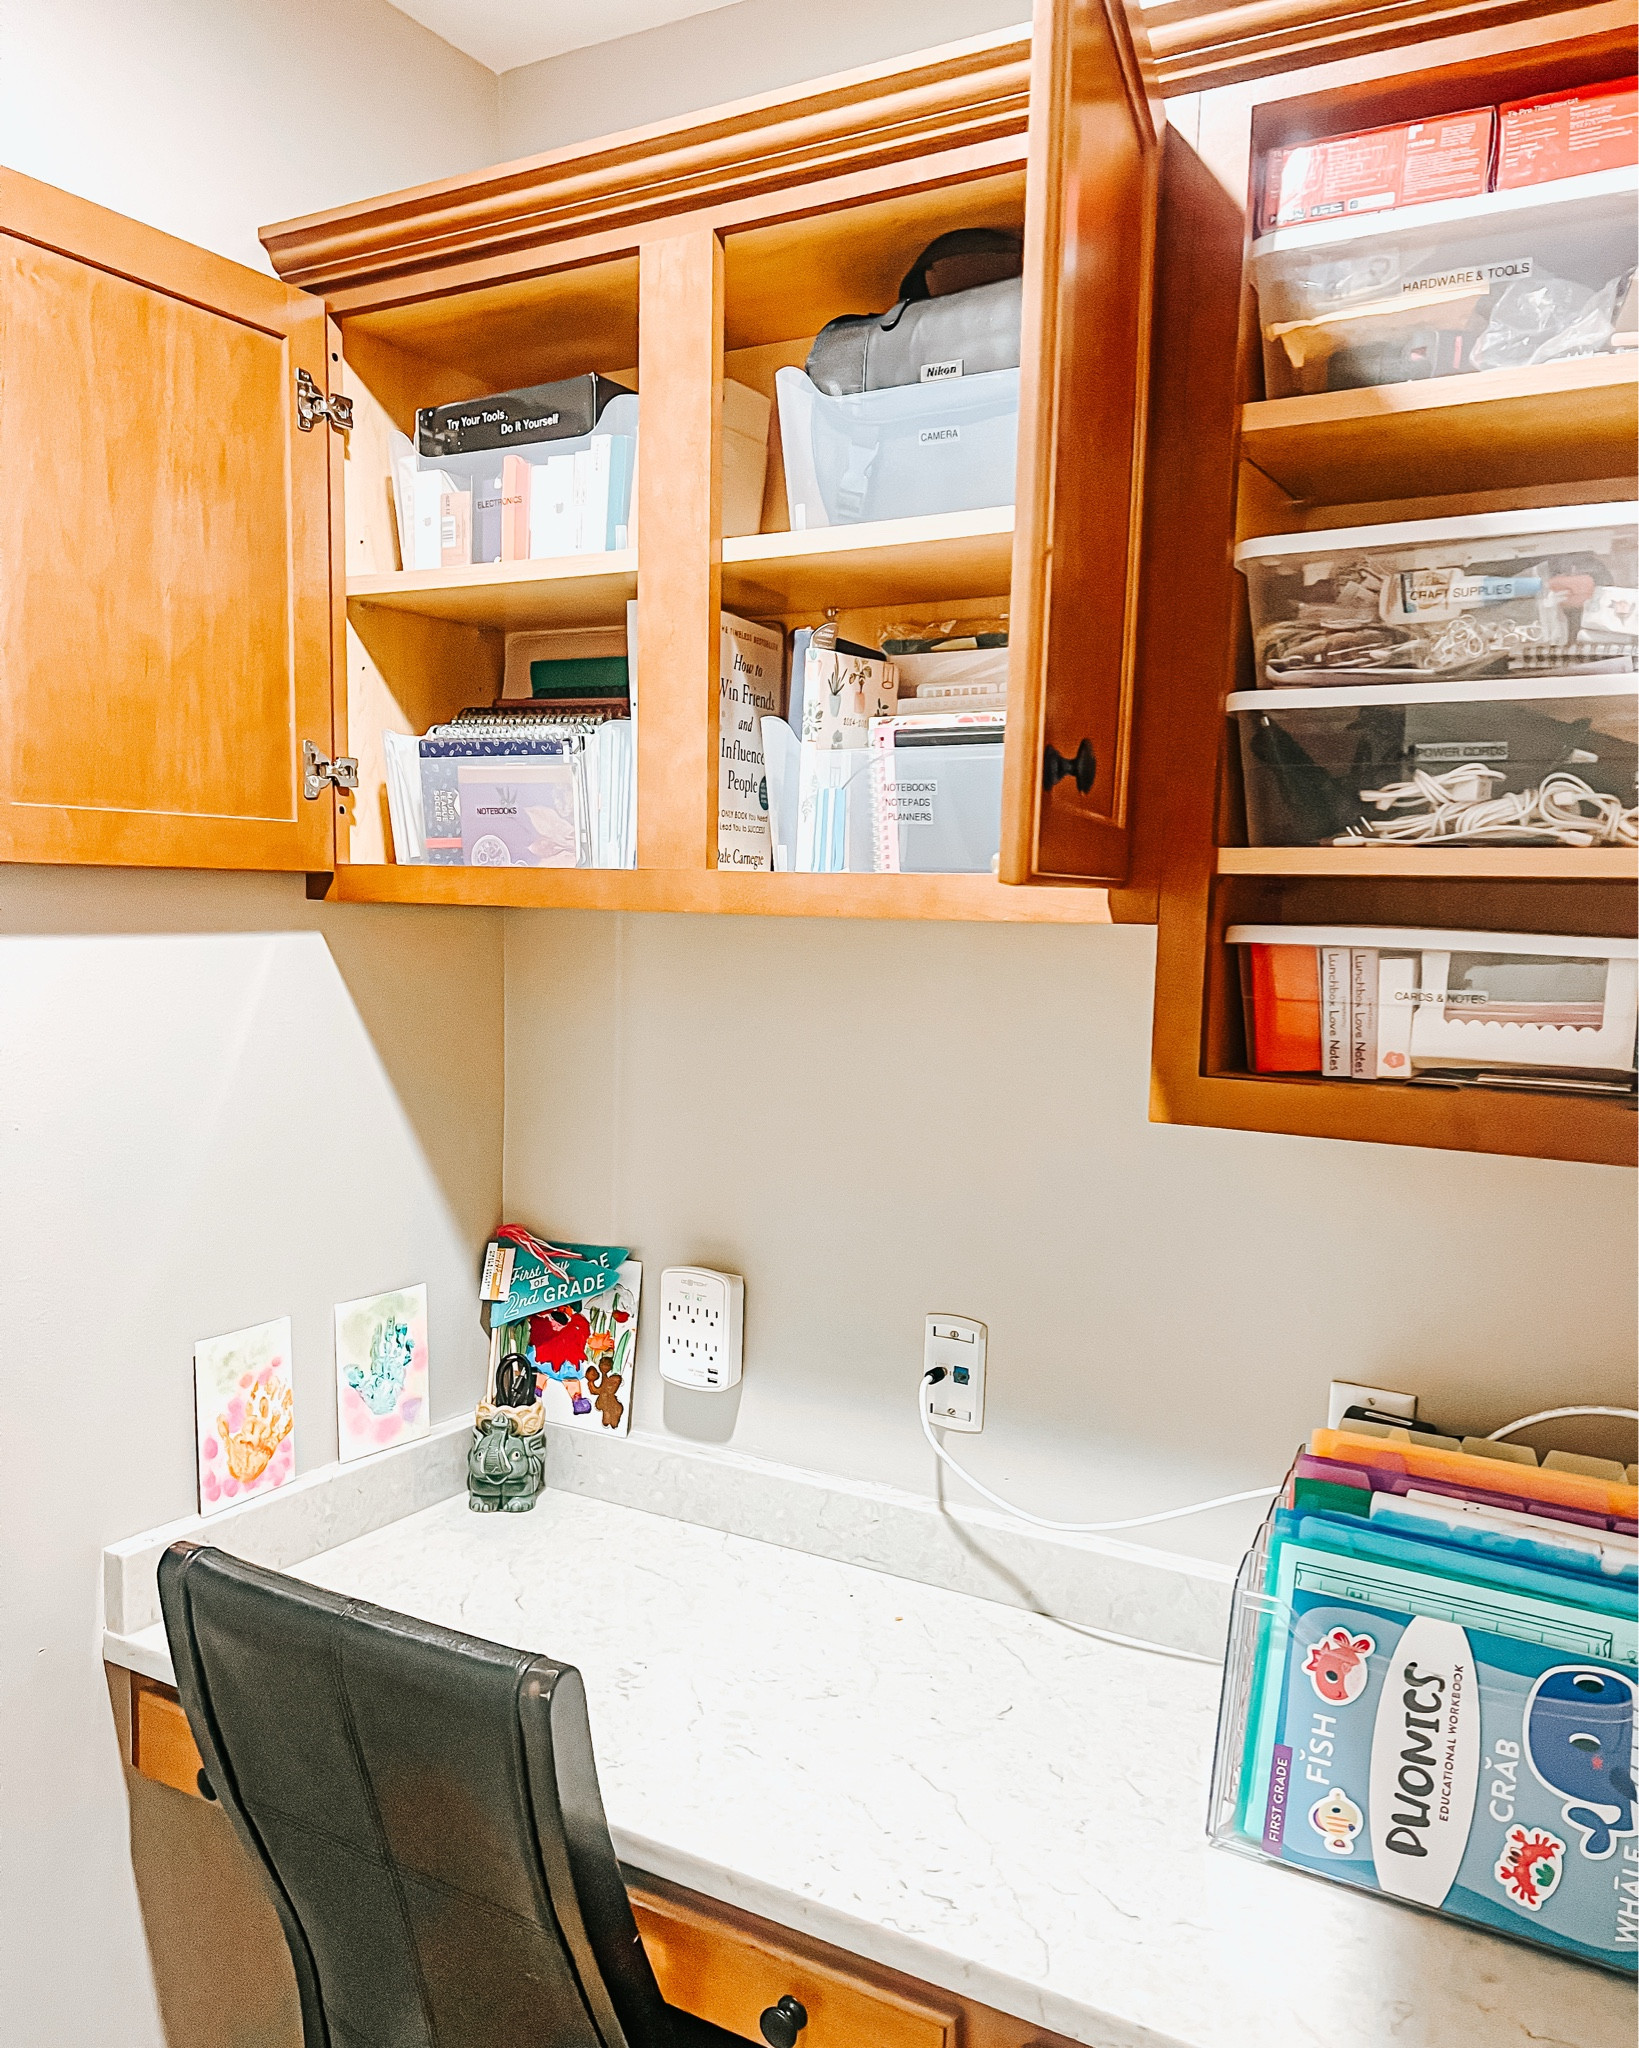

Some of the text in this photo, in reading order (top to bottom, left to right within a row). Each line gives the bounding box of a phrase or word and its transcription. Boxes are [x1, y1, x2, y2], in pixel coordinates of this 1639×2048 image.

[1402, 262, 1530, 292] HARDWARE & TOOLS
[926, 365, 957, 377] Nikon
[447, 409, 508, 431] Try Your Tools,
[501, 423, 513, 435] Do
[523, 413, 559, 430] Yourself
[920, 428, 959, 442] CAMERA
[477, 496, 523, 510] ELECTRONICS
[1410, 583, 1513, 601] CRAFT SUPPLIES
[733, 653, 763, 677] How to
[742, 684, 775, 711] Friends
[738, 717, 754, 732] and
[1416, 745, 1507, 758] POWER CORDS
[727, 769, 758, 799] People
[883, 783, 936, 792] NOTEBOOKS
[433, 790, 442, 822] SOCCER
[440, 790, 449, 822] LEAGUE
[446, 791, 456, 821] MAJOR
[476, 807, 518, 815] NOTEBOOKS
[885, 798, 931, 807] NOTEPADS
[887, 812, 932, 822] PLANNERS
[733, 848, 765, 870] Carnegie
[1394, 991, 1487, 1004] CARDS & NOTES
[1328, 953, 1340, 1071] Lunchbox Love Notes
[1355, 954, 1367, 1073] Lunchbox Love Notes
[510, 1265, 542, 1286] First
[533, 1278, 545, 1287] OF
[504, 1272, 606, 1319] 2nd GRADE
[1439, 1664, 1464, 1822] EDUCATIONAL WORKBOOK
[1385, 1661, 1446, 1858] PHONICS
[1268, 1757, 1288, 1842] FIRST GRADE
